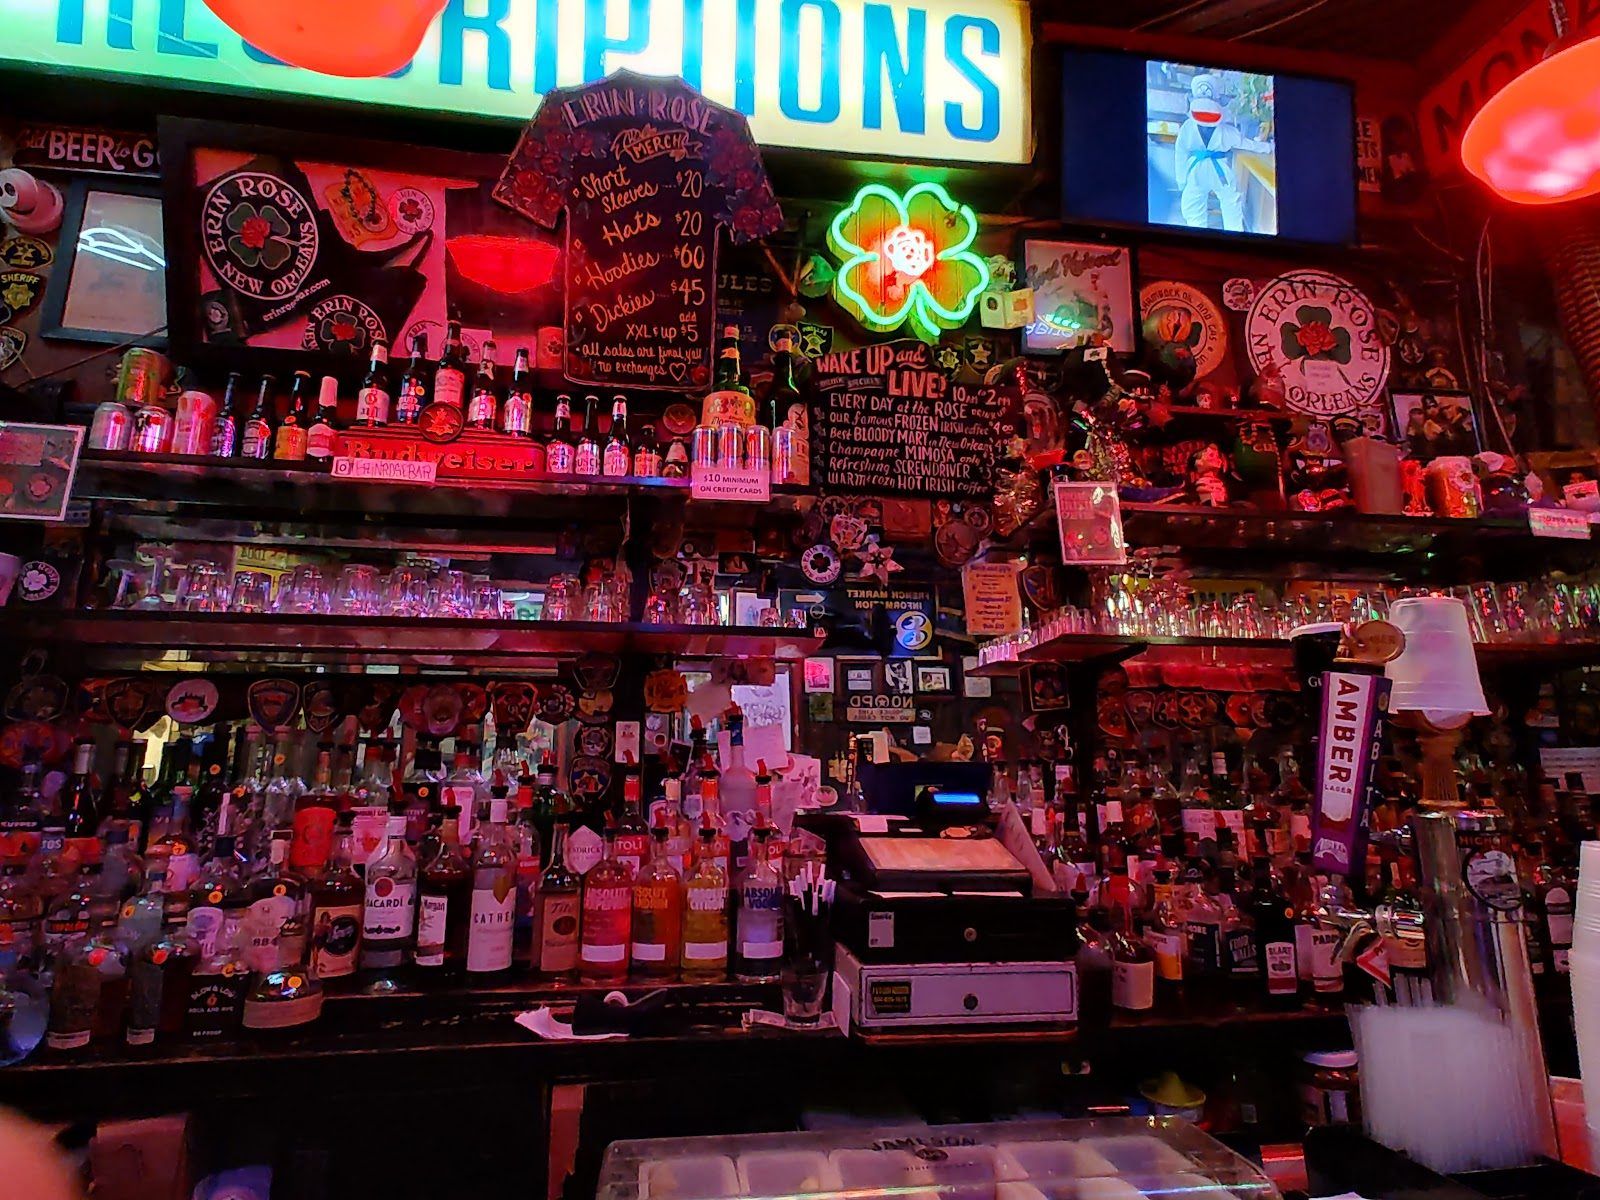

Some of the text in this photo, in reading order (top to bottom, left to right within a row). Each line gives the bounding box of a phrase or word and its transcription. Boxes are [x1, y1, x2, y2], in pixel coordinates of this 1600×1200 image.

[48, 131, 125, 171] BEER
[133, 139, 161, 168] G
[631, 134, 682, 159] MERCH
[581, 164, 703, 199] Short $20
[601, 181, 659, 214] Sleeves
[206, 177, 304, 254] ERIN ROSE
[602, 208, 703, 247] Hats $20
[270, 221, 314, 296] ORLEANS
[584, 242, 705, 290] Hoodies $60
[1, 273, 40, 284] SHERIFF
[221, 261, 265, 294] NEW
[590, 278, 705, 332] Dickies $45
[679, 311, 697, 323] add
[312, 298, 387, 347] ERIN ROS
[625, 324, 652, 340] XXL
[660, 327, 677, 344] up
[680, 324, 699, 342] $5
[1258, 279, 1380, 363] ERIN ROSE
[582, 342, 600, 357] all
[603, 342, 635, 357] sales
[636, 345, 655, 357] are
[815, 344, 926, 376] WAKE UP and
[597, 361, 667, 382] no exchanges
[830, 393, 867, 410] EVERY
[870, 397, 894, 411] DAY
[897, 401, 909, 412] at
[911, 401, 931, 415] the
[934, 401, 968, 420] ROSE
[1288, 372, 1377, 412] ORLEANS
[829, 412, 850, 424] OUR
[851, 411, 893, 427] famous
[894, 414, 938, 432] FROZEN
[940, 421, 964, 433] IRISH
[829, 427, 851, 441] Best
[853, 427, 896, 443] BLOODY
[897, 429, 929, 446] MARY
[829, 441, 900, 461] Champagne
[905, 445, 955, 463] MIMOSA
[959, 454, 981, 466] only
[829, 456, 890, 476] Refreshing
[894, 460, 971, 479] SCREWDRIVER
[700, 485, 763, 495] ON CREDIT CARDS
[703, 473, 759, 485] $10 MINIMUM
[828, 472, 866, 486] WARM
[871, 475, 896, 489] cozy
[897, 476, 923, 491] HOT
[925, 478, 955, 494] IRISH
[957, 481, 988, 496] coffee
[1328, 678, 1360, 783] AMBER
[1360, 719, 1382, 828] ABITA
[1323, 783, 1353, 794] LAGER
